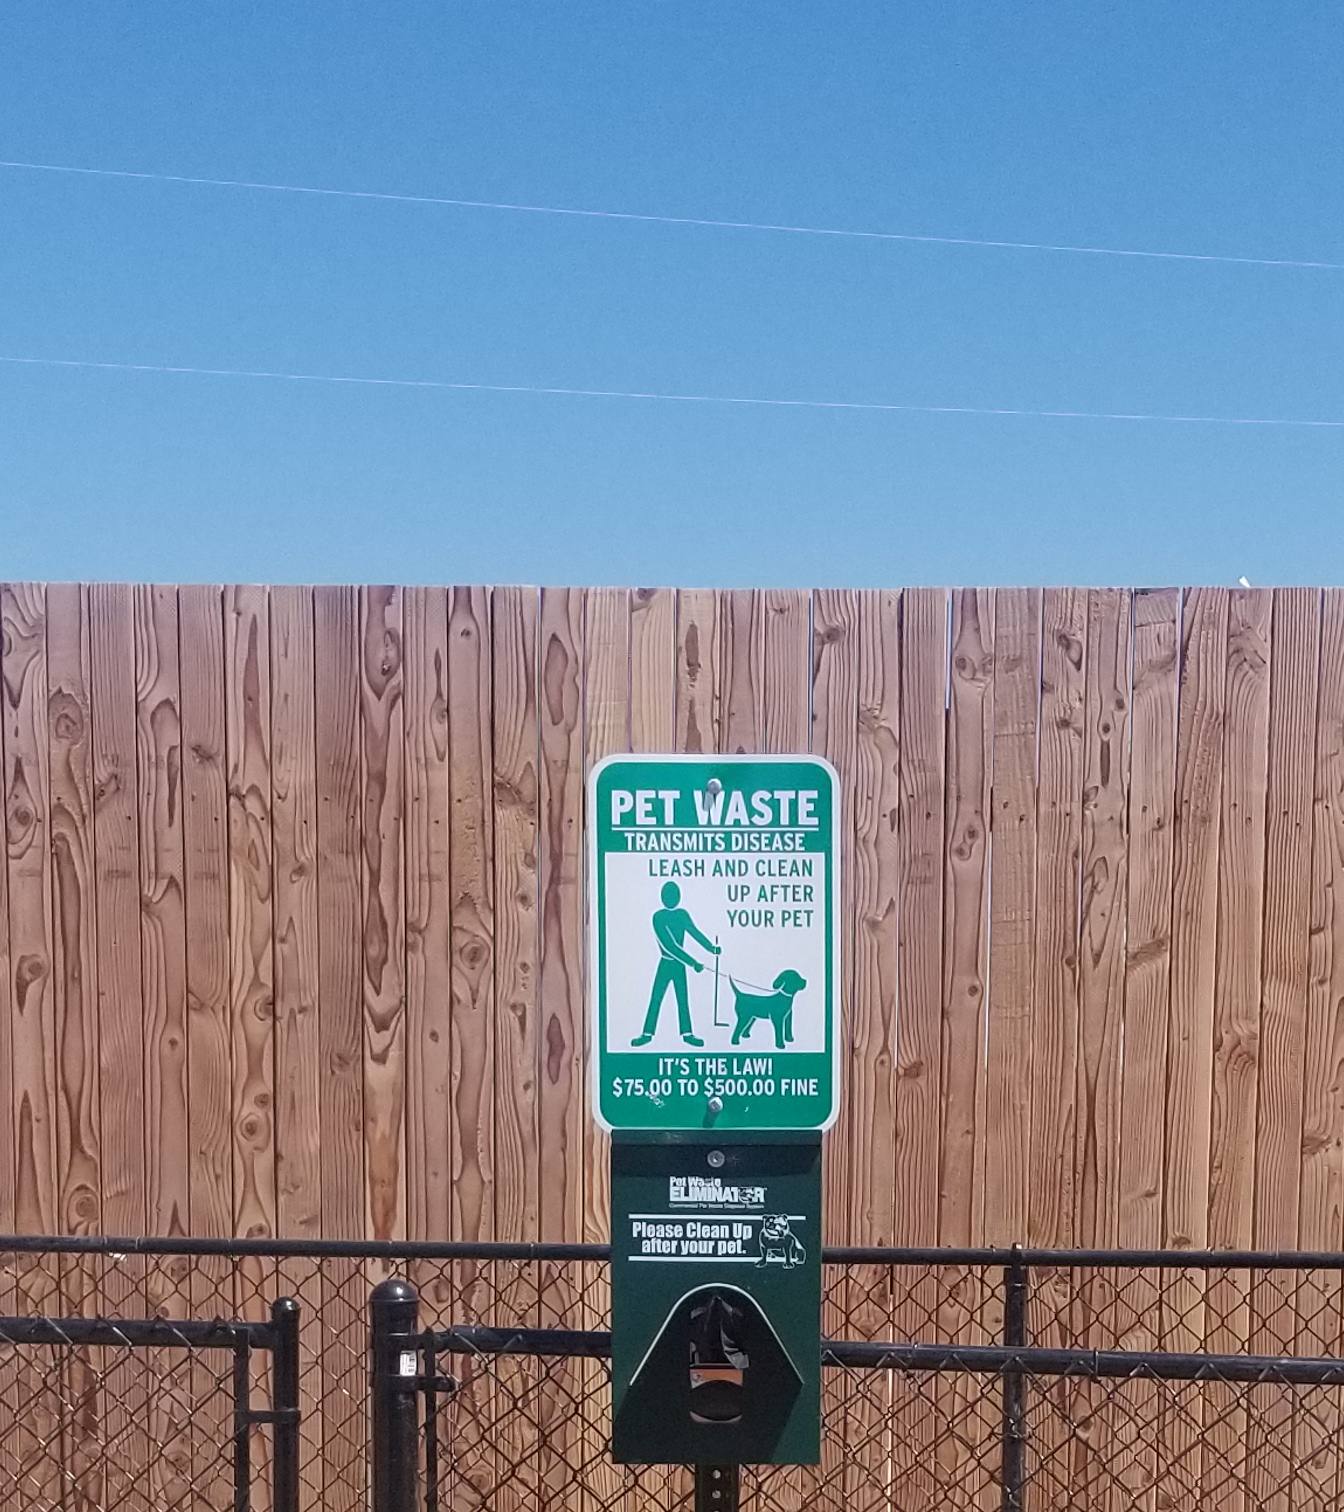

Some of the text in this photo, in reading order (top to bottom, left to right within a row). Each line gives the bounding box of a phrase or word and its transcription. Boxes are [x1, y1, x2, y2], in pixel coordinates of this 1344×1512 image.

[612, 790, 819, 825] PET WASTE
[624, 832, 805, 851] TRANSMITS DISEASE
[649, 859, 813, 877] LEASH AND CLEAN
[727, 885, 814, 903] UP AFTER
[727, 910, 814, 928] YOUR PET
[659, 1058, 773, 1076] IT'S THE LAW!
[612, 1077, 819, 1098] $75.00 TO $500.00 FINE
[669, 1176, 687, 1187] Pet
[632, 1221, 753, 1240] Please Clean Up
[641, 1238, 747, 1256] after your pet.
